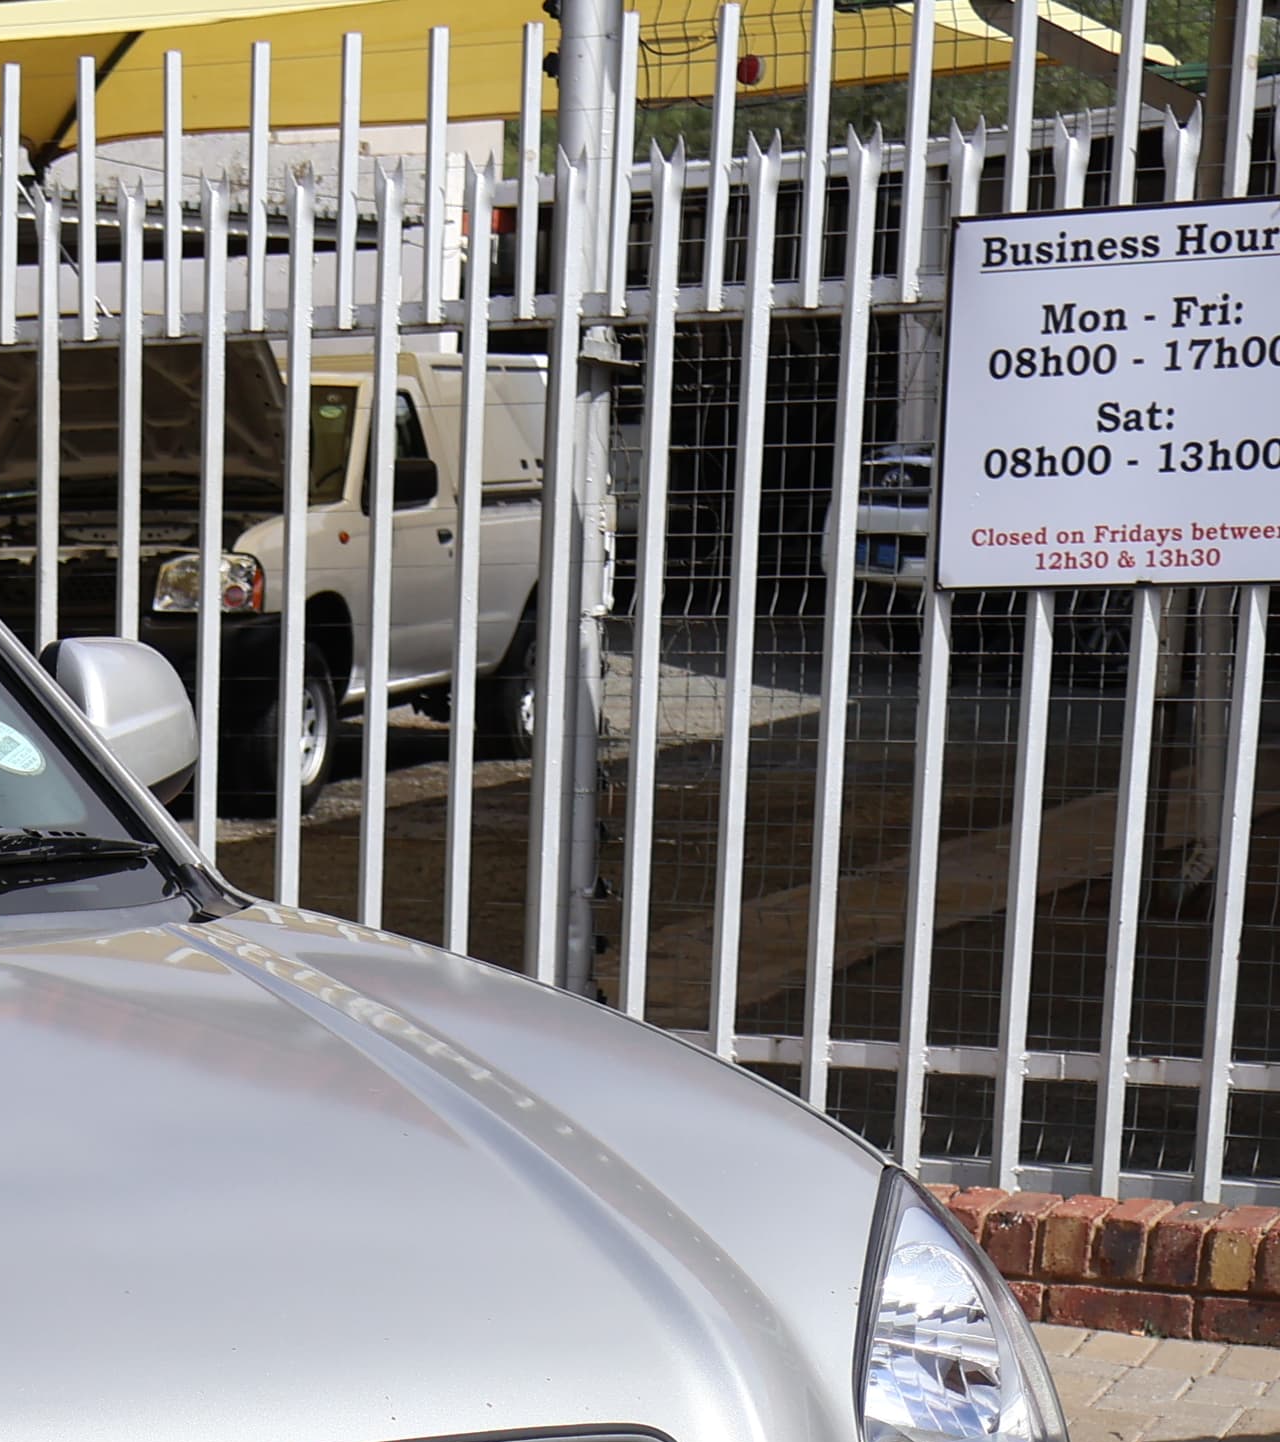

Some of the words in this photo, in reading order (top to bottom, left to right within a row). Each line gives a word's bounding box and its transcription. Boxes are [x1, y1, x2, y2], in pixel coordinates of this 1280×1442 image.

[982, 231, 1160, 268] Business
[1175, 223, 1280, 256] Hour
[1040, 303, 1128, 335] Mon
[1171, 293, 1244, 328] Fri:
[989, 344, 1118, 379] 08h00
[1096, 401, 1176, 433] Sat:
[984, 445, 1112, 479] 08h00
[1157, 438, 1280, 473] 13h00
[971, 528, 1048, 546] Closed
[1055, 530, 1085, 543] on
[1094, 524, 1183, 546] Fridays
[1191, 521, 1280, 541] betwee
[1035, 551, 1109, 570] 12h30
[1117, 552, 1136, 567] &
[1144, 547, 1221, 567] 13h30
